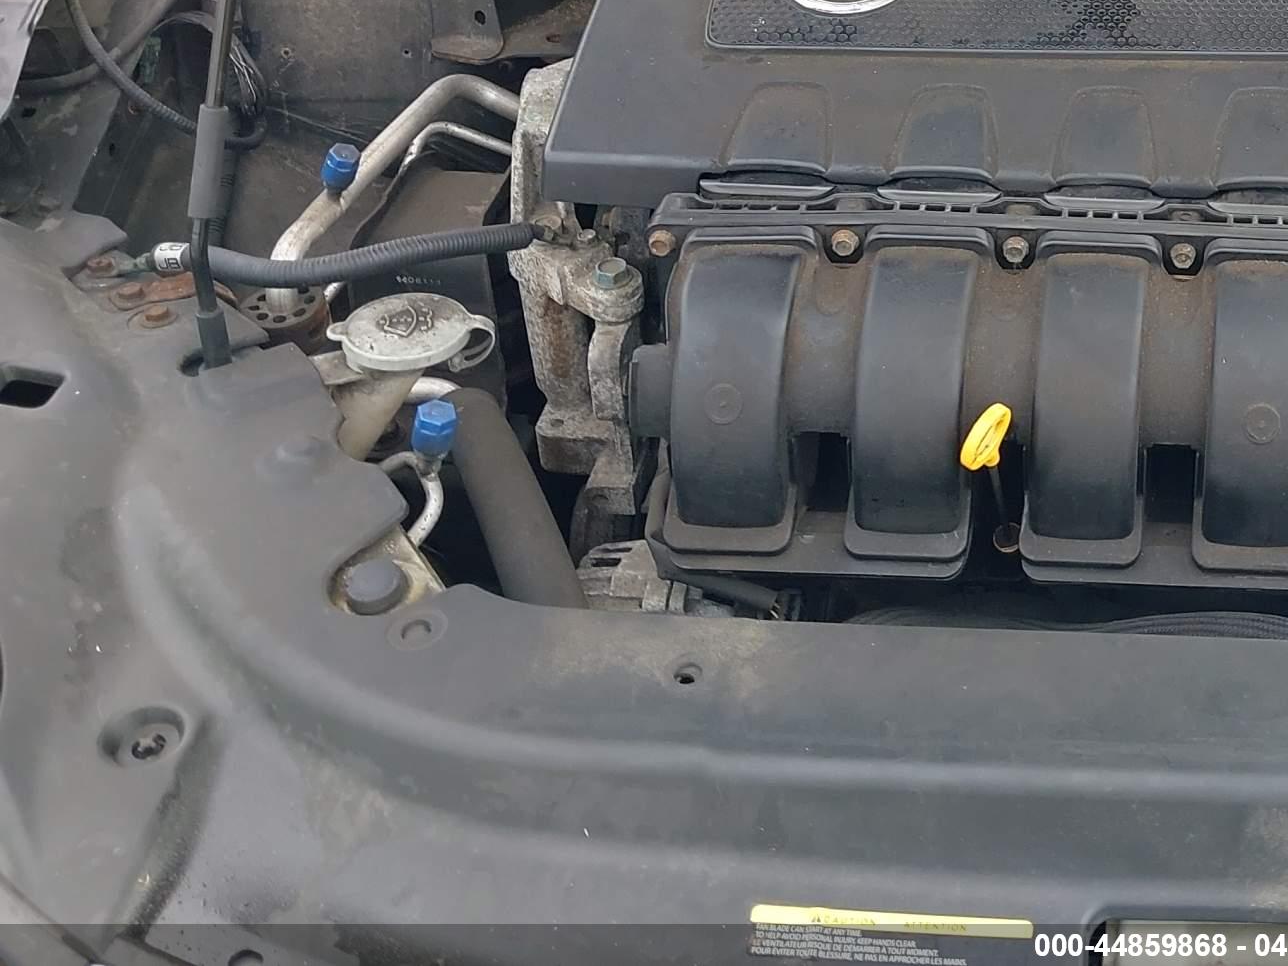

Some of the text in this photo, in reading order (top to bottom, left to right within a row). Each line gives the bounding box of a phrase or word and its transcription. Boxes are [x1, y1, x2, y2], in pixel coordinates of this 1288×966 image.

[769, 924, 789, 932] BLADE
[802, 934, 832, 942] PERSONAL
[762, 940, 806, 948] VENTILATEUR
[931, 957, 942, 965] LES
